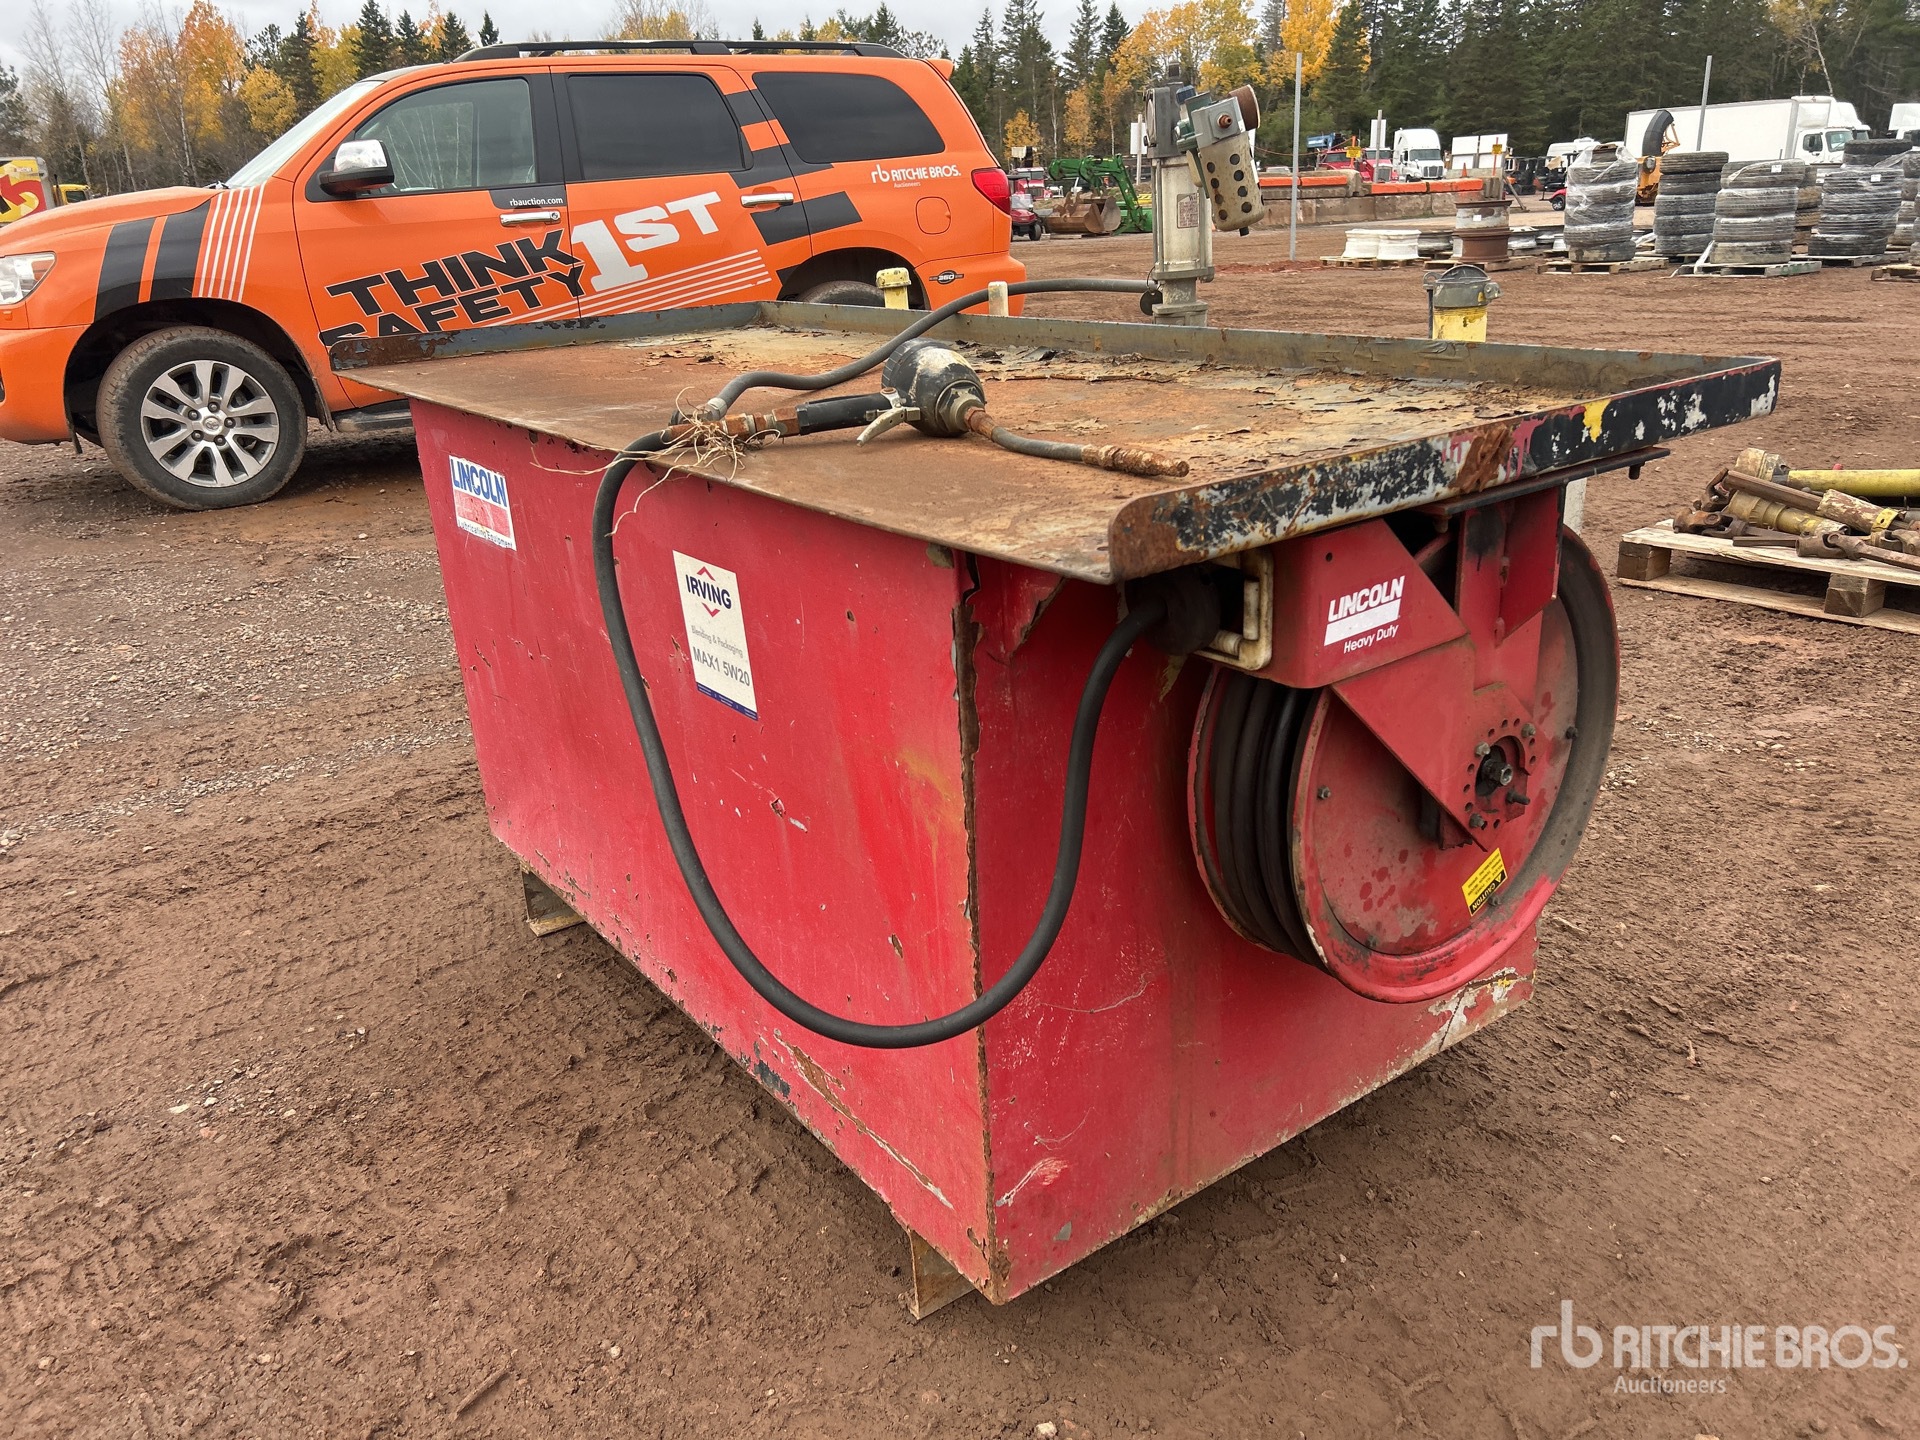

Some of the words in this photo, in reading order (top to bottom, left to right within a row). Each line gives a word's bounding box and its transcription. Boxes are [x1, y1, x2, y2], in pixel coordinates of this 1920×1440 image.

[891, 167, 929, 182] RITCHIE
[928, 164, 962, 180] BROS.
[509, 197, 564, 207] rbauction.com
[572, 191, 721, 292] 1ST
[324, 228, 584, 317] THINK
[449, 458, 508, 508] LINCOLN
[685, 573, 732, 610] IRVING
[1328, 575, 1406, 622] LINCOLN
[712, 634, 719, 644] &
[1343, 633, 1376, 654] Heavy
[1376, 625, 1399, 642] Duty
[692, 646, 721, 673] MAX1
[722, 661, 751, 687] 5W20
[1472, 882, 1496, 911] CAUTION
